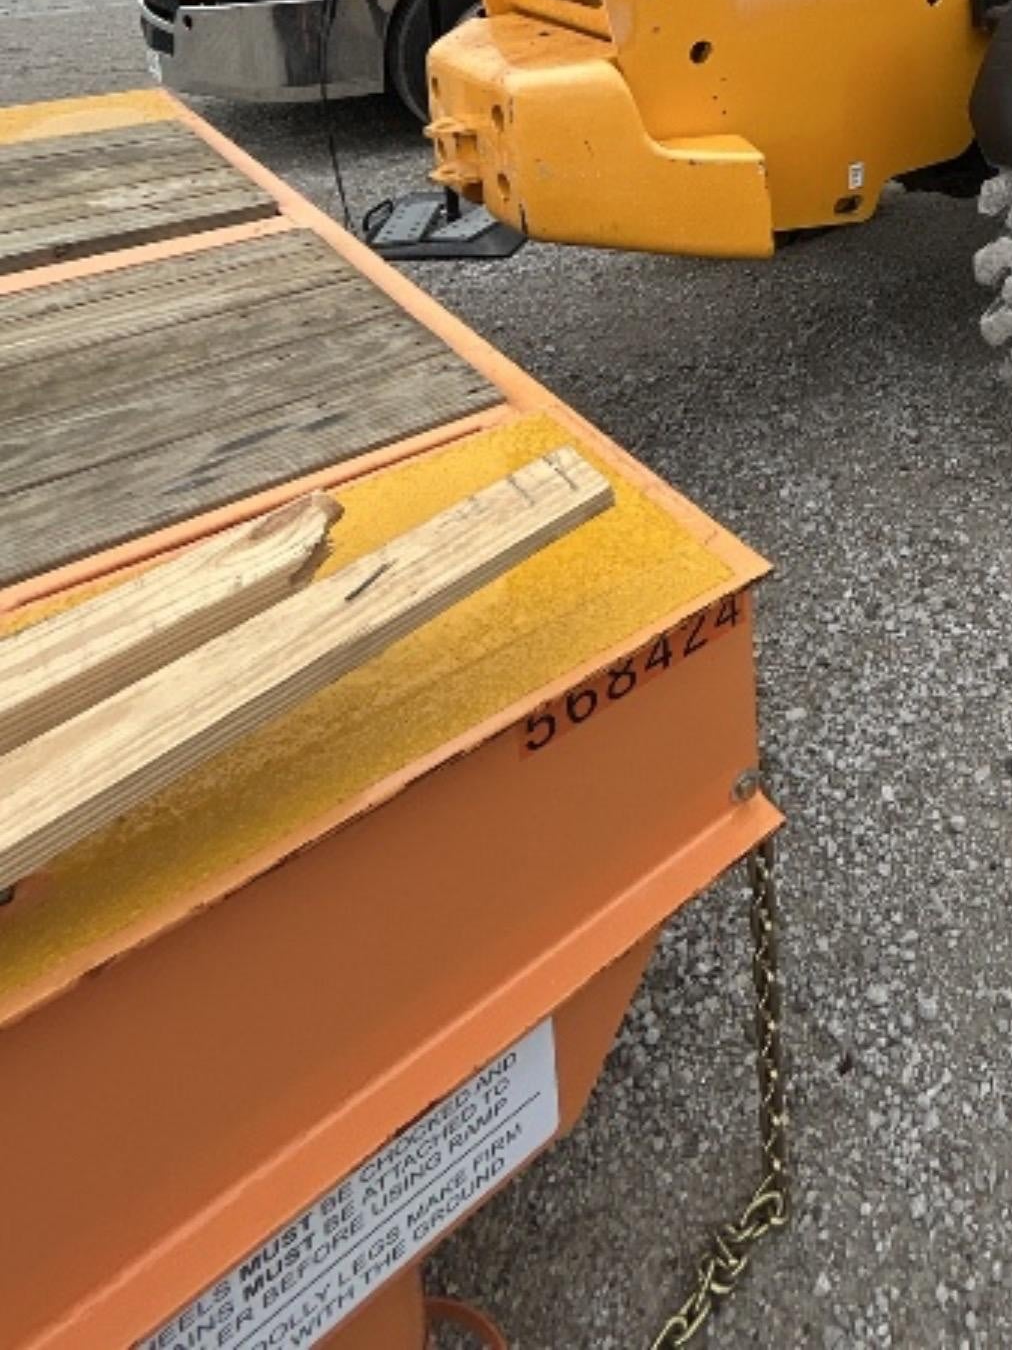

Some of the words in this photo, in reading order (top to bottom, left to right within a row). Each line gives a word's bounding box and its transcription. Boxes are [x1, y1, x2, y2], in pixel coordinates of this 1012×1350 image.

[525, 593, 740, 751] 568424
[239, 1212, 312, 1282] MUST
[321, 1180, 353, 1216] BE
[359, 1089, 471, 1183] CHOCKED
[476, 1052, 517, 1091] AND
[242, 1232, 315, 1302] MUST
[323, 1201, 355, 1235] BE
[363, 1103, 477, 1206] ATTACHED
[484, 1077, 510, 1105] TO
[263, 1211, 364, 1309] BEFORE
[371, 1151, 442, 1216] USING
[448, 1097, 509, 1154] RAMP
[289, 1285, 354, 1346] WITH
[360, 1238, 406, 1285] THE
[412, 1157, 505, 1241] GROUND
[338, 1226, 400, 1286] LEGS
[406, 1168, 468, 1228] MAKE
[473, 1123, 523, 1174] FIRM
